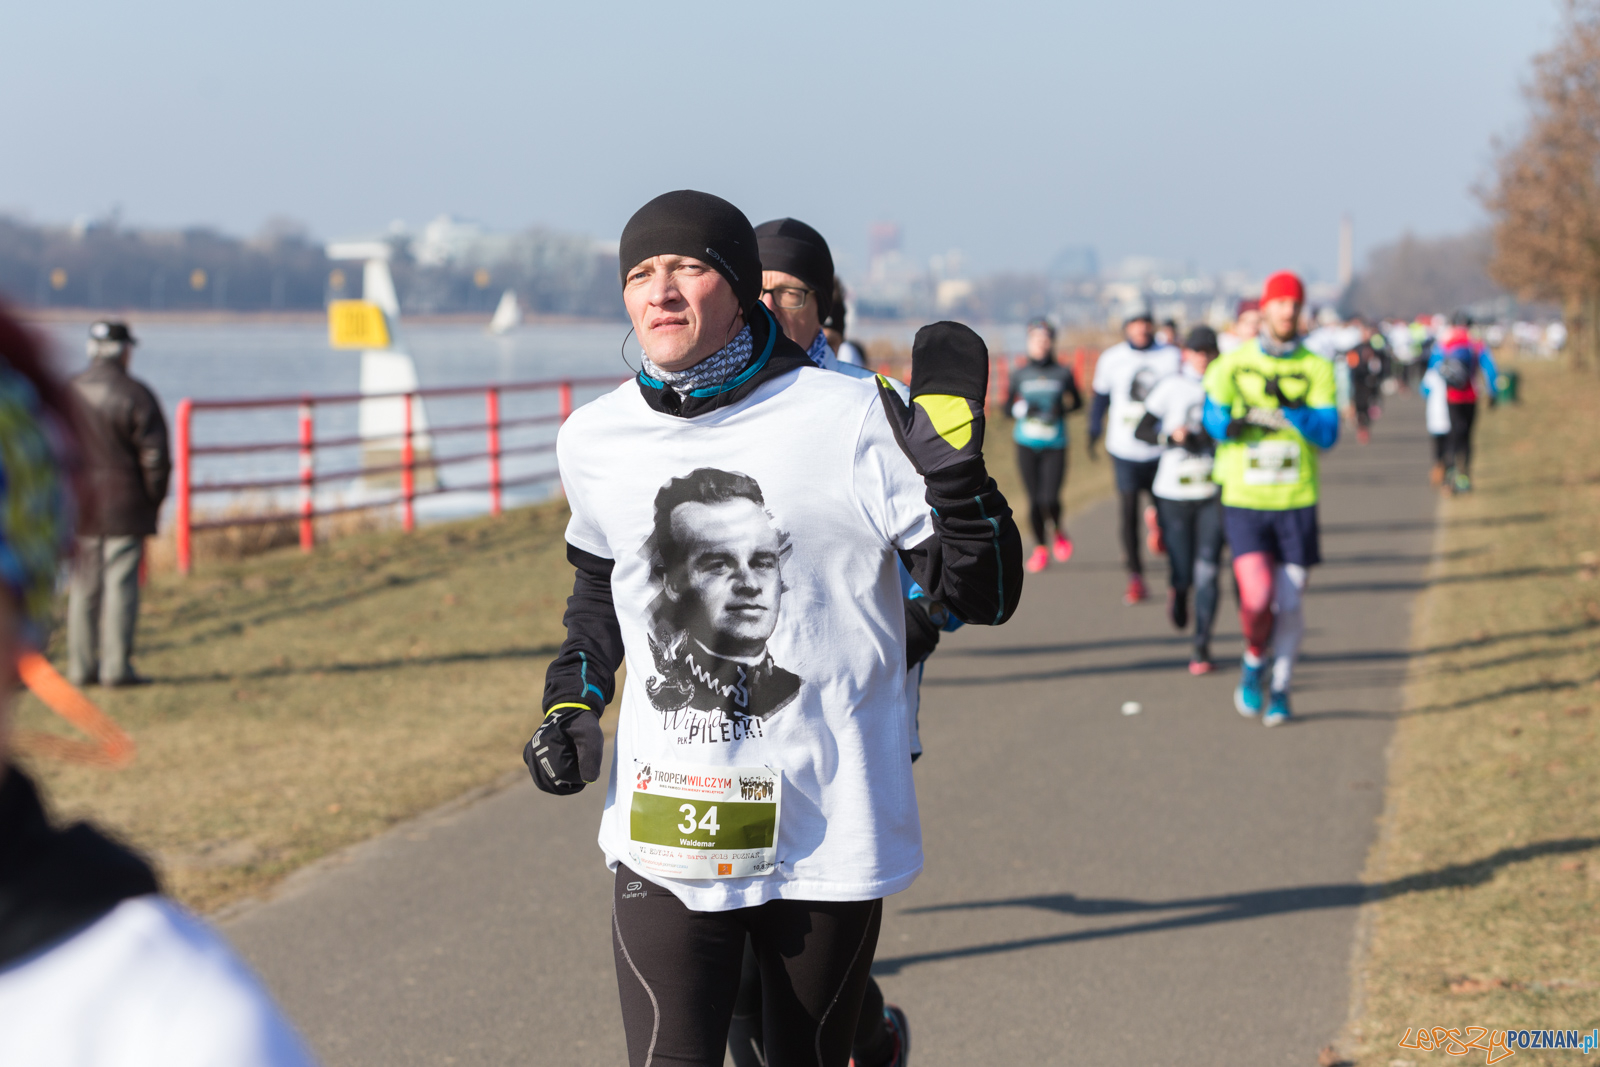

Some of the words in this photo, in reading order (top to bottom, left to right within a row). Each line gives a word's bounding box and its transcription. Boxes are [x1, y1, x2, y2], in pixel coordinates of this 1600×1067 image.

[688, 718, 763, 745] PILECKI
[677, 803, 720, 836] 34
[679, 838, 716, 848] Waldemar
